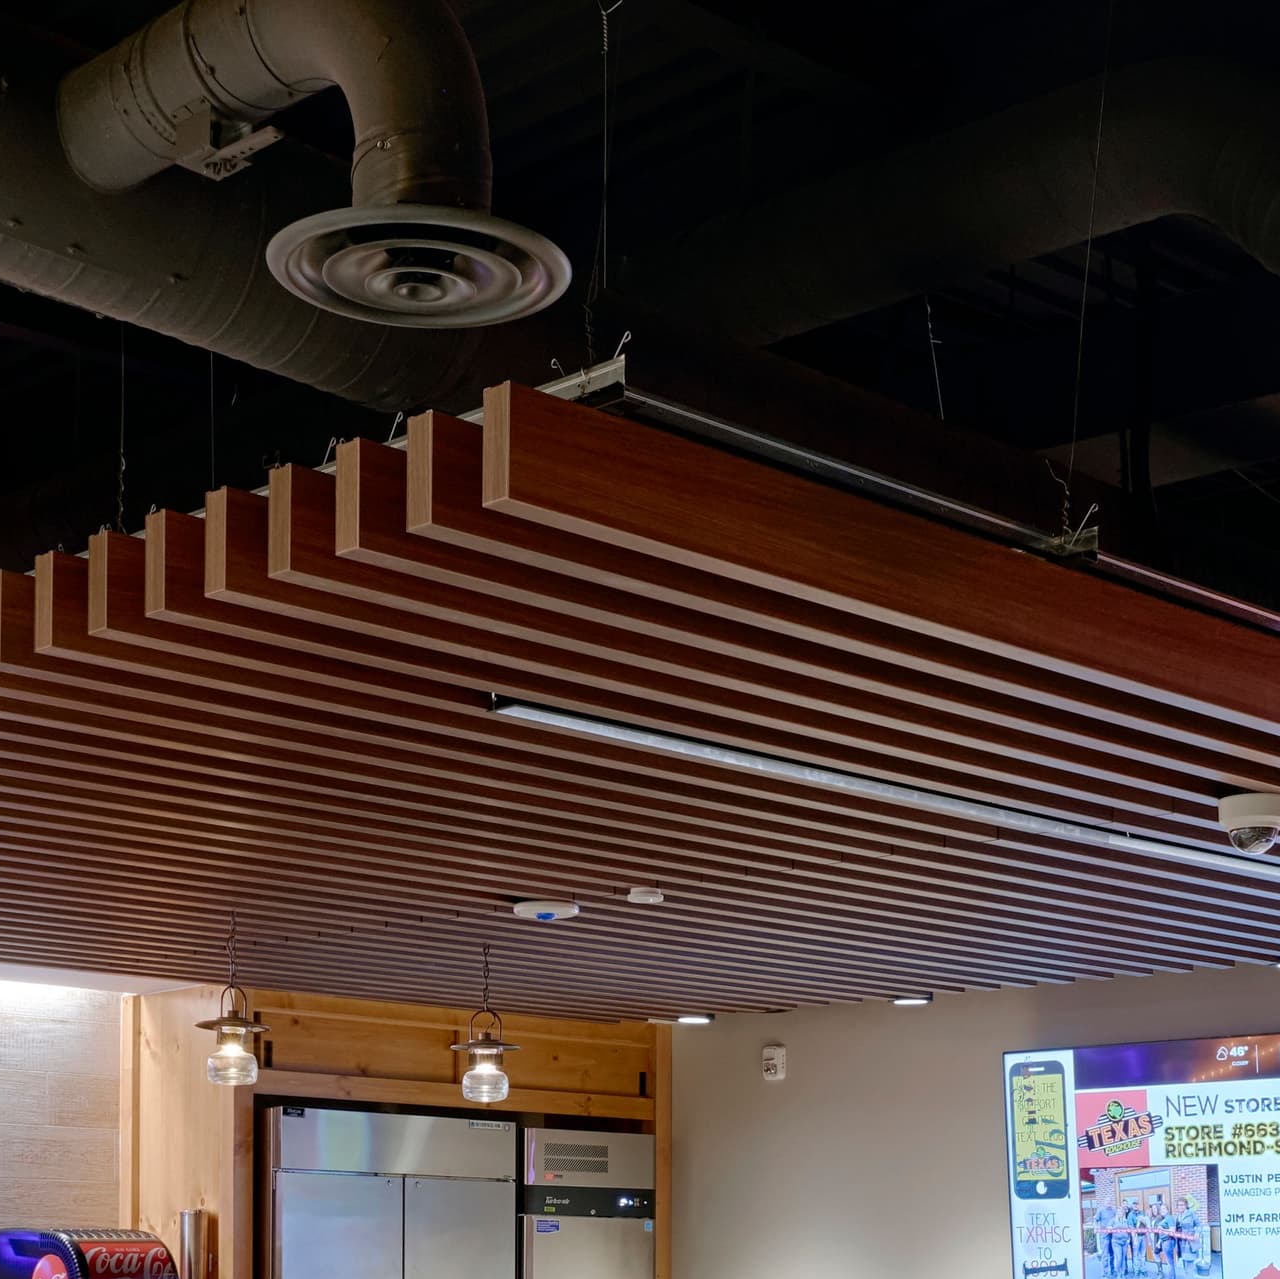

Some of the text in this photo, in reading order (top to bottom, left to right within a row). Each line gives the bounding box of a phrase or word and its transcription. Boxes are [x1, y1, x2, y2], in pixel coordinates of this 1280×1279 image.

[1165, 1094, 1219, 1118] NEW
[1088, 1114, 1152, 1148] TEXAS
[1164, 1121, 1280, 1142] STORE #663
[1223, 1174, 1263, 1184] JUSTIN
[1223, 1188, 1272, 1197] MANAGING
[1028, 1212, 1056, 1226] TEXT
[1224, 1213, 1245, 1223] JIM
[1016, 1225, 1071, 1244] TXRHSC
[1225, 1227, 1262, 1237] MARKET
[1037, 1246, 1053, 1260] TO
